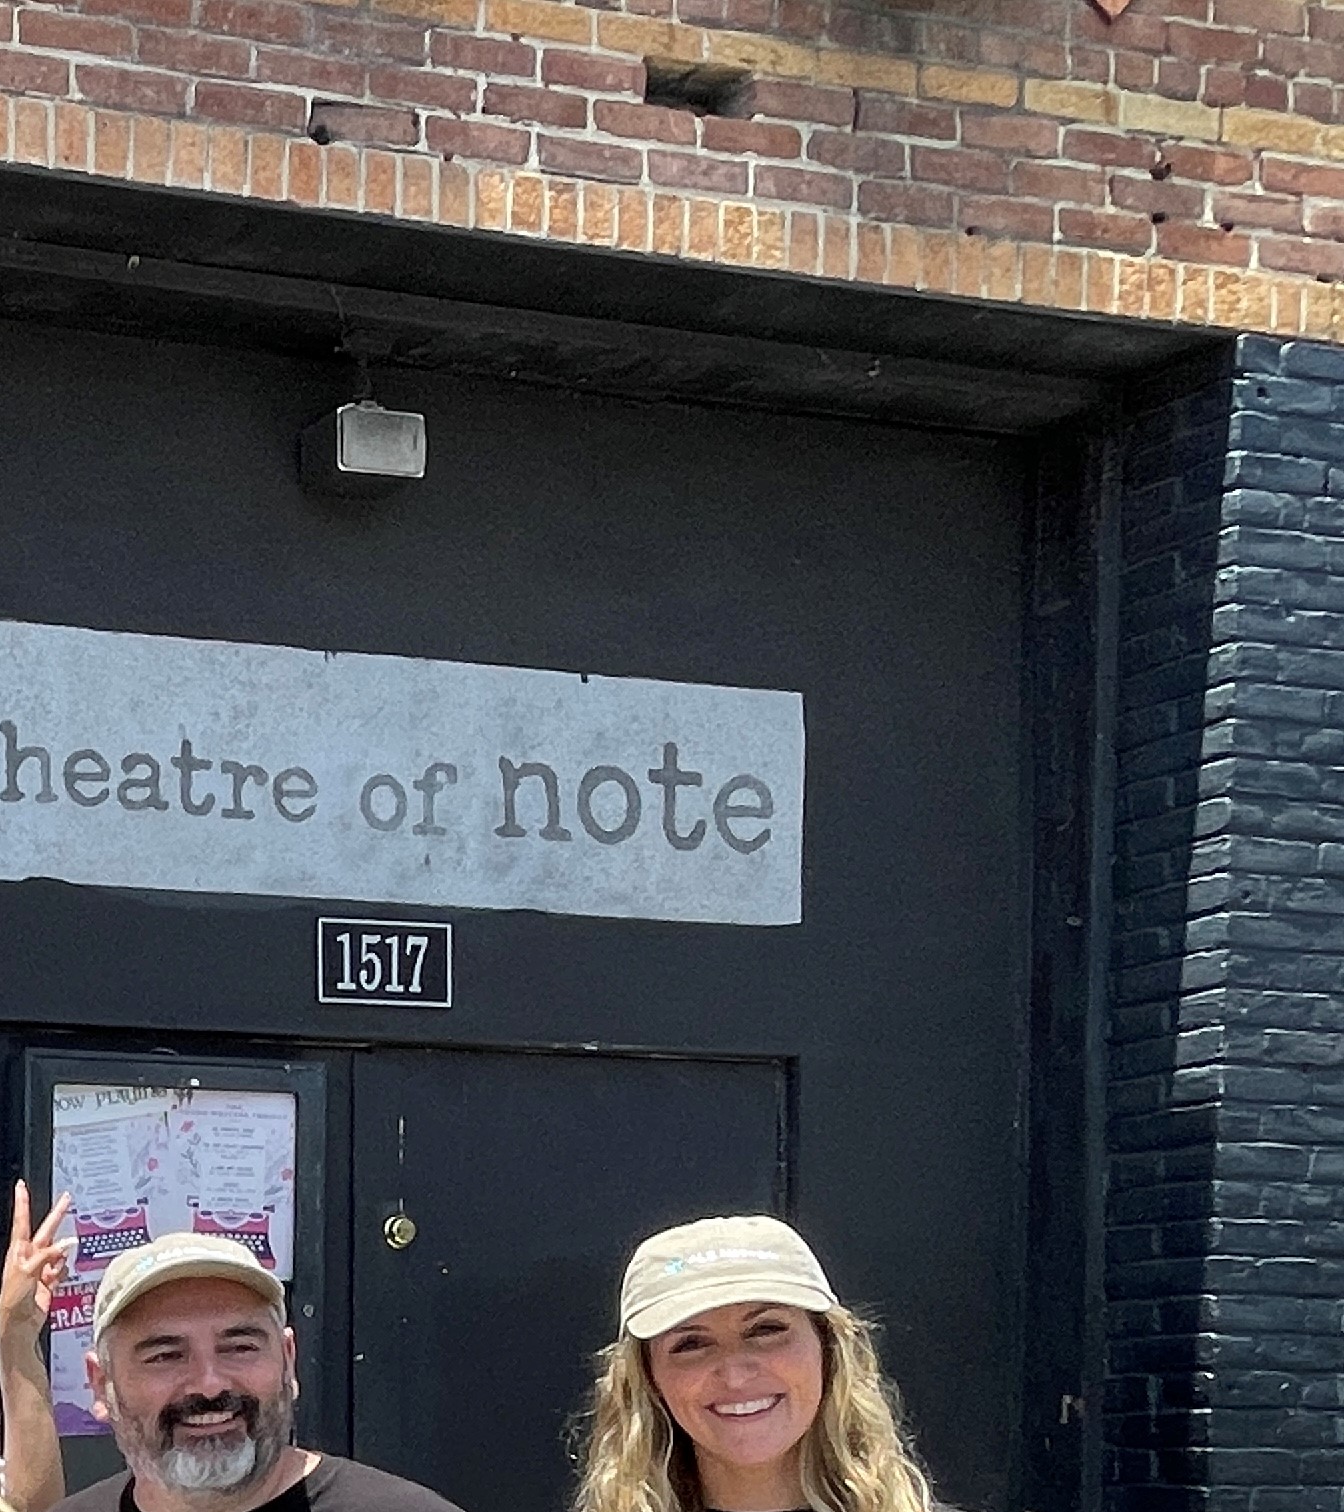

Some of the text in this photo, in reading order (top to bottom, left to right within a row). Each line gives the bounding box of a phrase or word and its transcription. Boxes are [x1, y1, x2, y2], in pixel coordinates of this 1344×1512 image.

[360, 762, 457, 836] of
[494, 742, 776, 856] note
[335, 932, 429, 997] 1517
